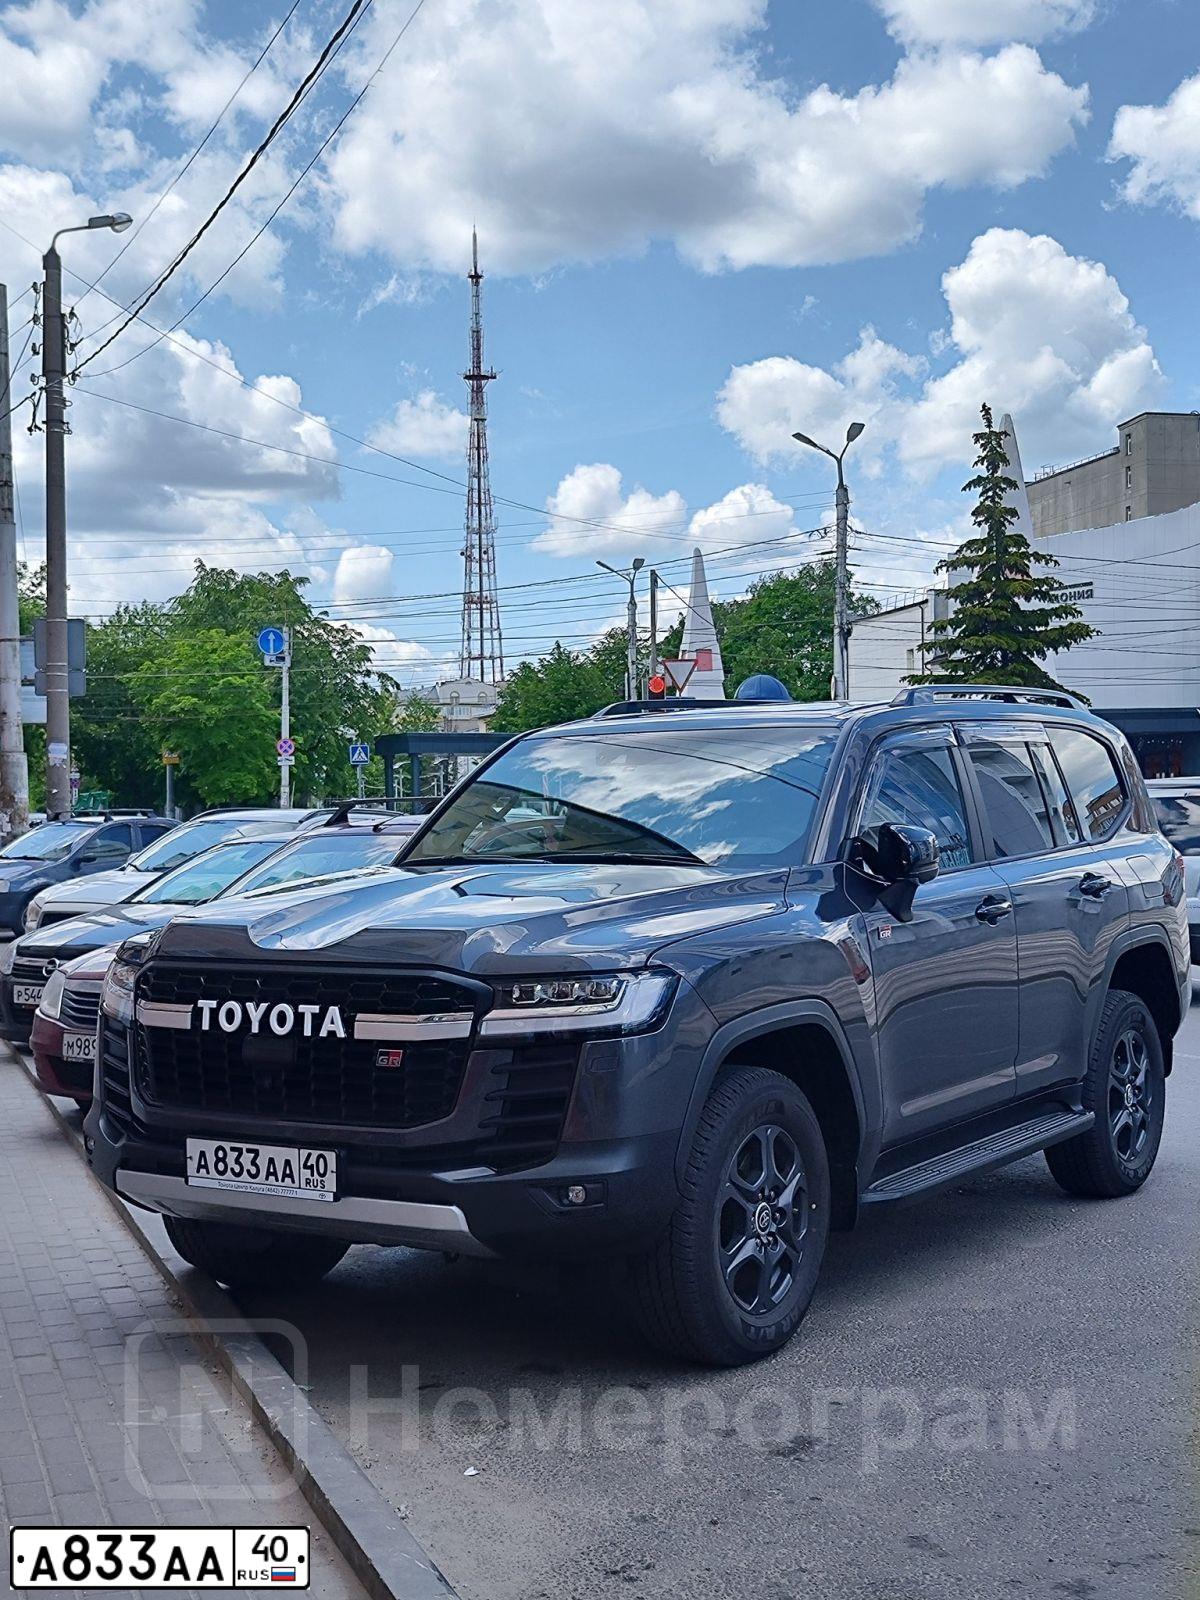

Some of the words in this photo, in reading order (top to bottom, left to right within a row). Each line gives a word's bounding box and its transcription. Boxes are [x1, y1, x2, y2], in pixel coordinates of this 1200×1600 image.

[197, 1000, 347, 1038] TOYOTA
[377, 1055, 402, 1067] GR
[196, 1145, 296, 1184] А833АА
[302, 1152, 328, 1178] 40
[305, 1178, 326, 1190] RUS
